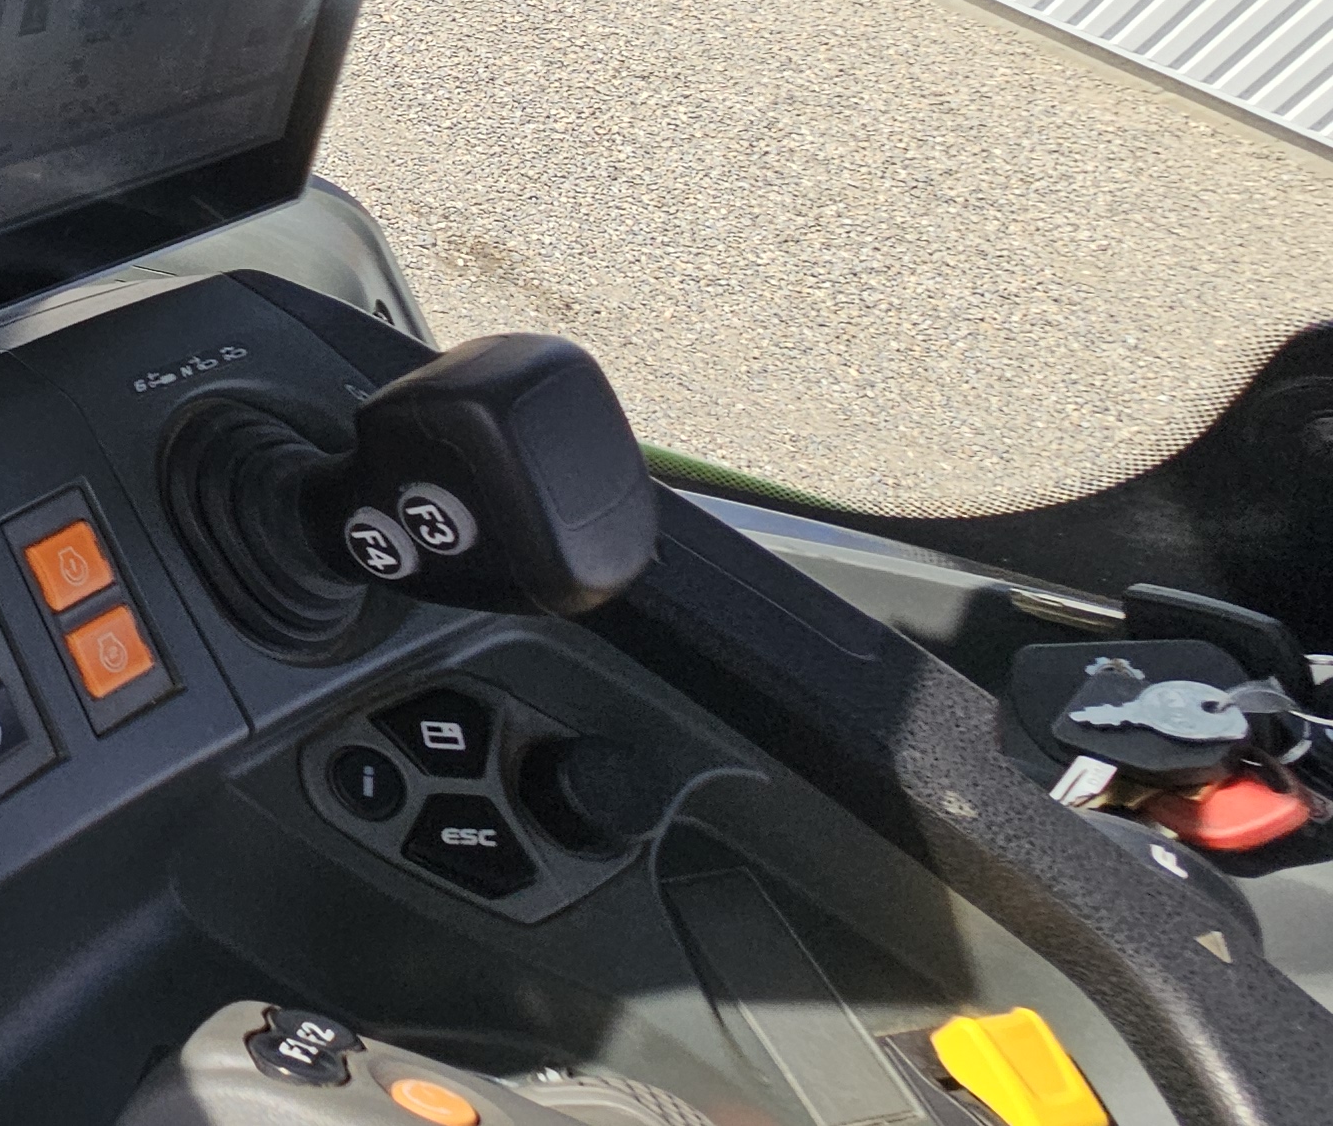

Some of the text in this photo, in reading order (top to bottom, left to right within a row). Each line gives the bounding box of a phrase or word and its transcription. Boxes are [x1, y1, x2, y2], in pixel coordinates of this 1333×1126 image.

[405, 504, 456, 545] F3
[351, 530, 399, 571] F4
[440, 827, 498, 847] ESC
[296, 1021, 335, 1046] F2
[278, 1038, 319, 1064] F1
